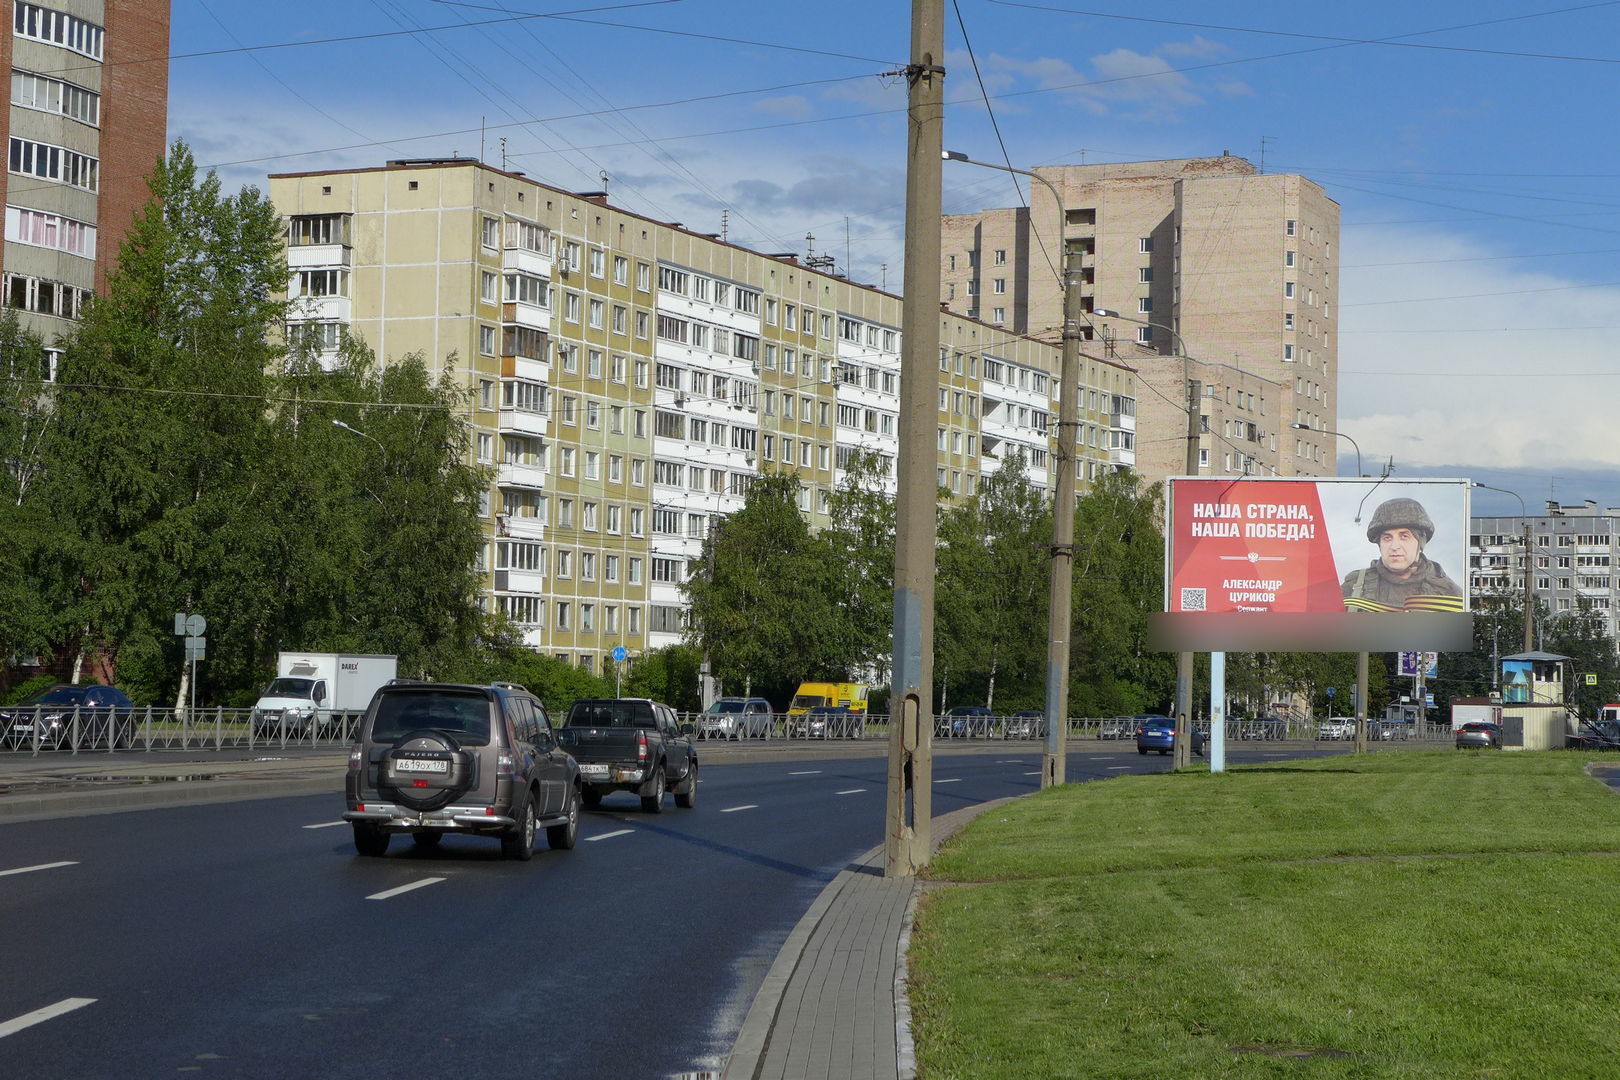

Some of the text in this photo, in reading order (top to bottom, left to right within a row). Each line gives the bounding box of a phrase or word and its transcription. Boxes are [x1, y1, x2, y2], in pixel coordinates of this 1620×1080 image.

[1193, 503, 1314, 522] НАША СТРАНА,
[1191, 522, 1315, 541] НАША ПОБЕДА!
[1222, 579, 1283, 591] АЛЕКСАНДР
[1229, 592, 1276, 603] ЦУРИКОВ
[341, 662, 359, 670] DAREX
